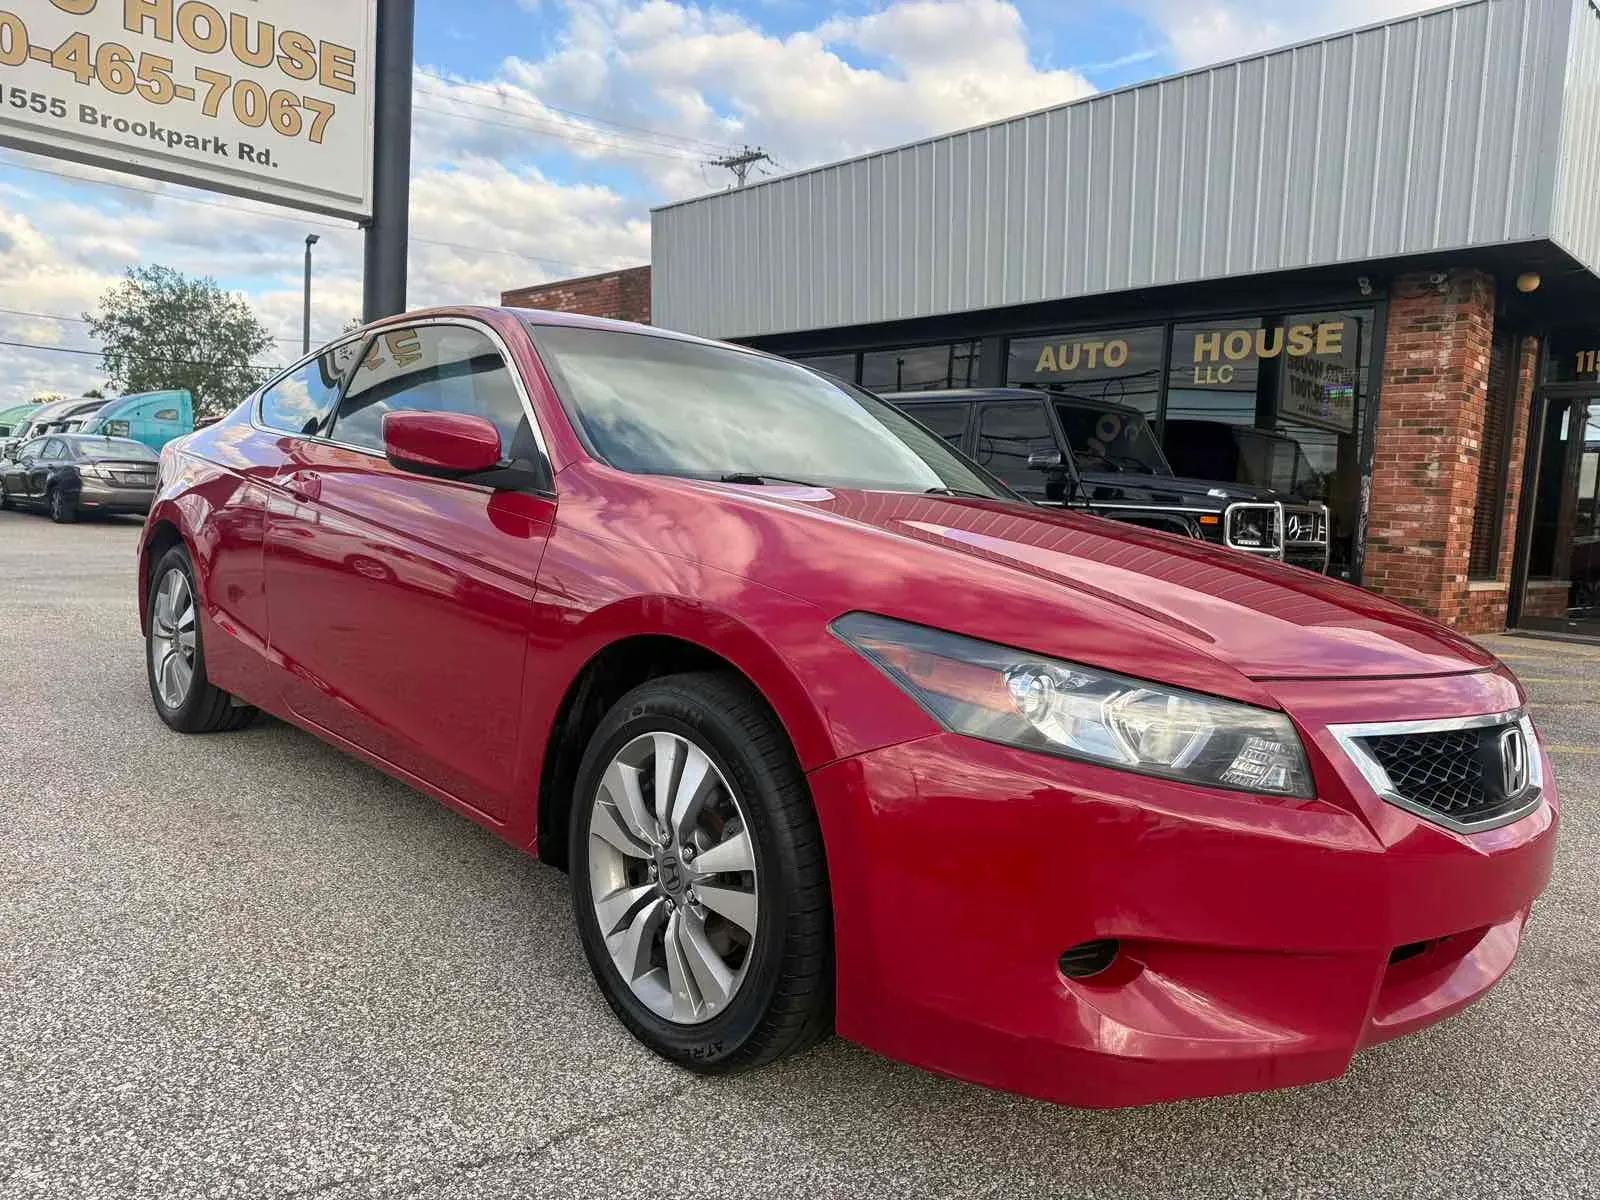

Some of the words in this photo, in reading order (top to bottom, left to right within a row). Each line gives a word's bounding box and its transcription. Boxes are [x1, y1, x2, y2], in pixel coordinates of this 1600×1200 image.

[0, 10, 336, 145] 0-465-7067
[123, 0, 356, 95] HOUSE
[79, 103, 229, 157] Brookpark
[238, 142, 279, 168] Rd.
[1035, 339, 1129, 373] AUTO
[1192, 322, 1345, 363] HOUSE
[1193, 365, 1234, 385] LLC
